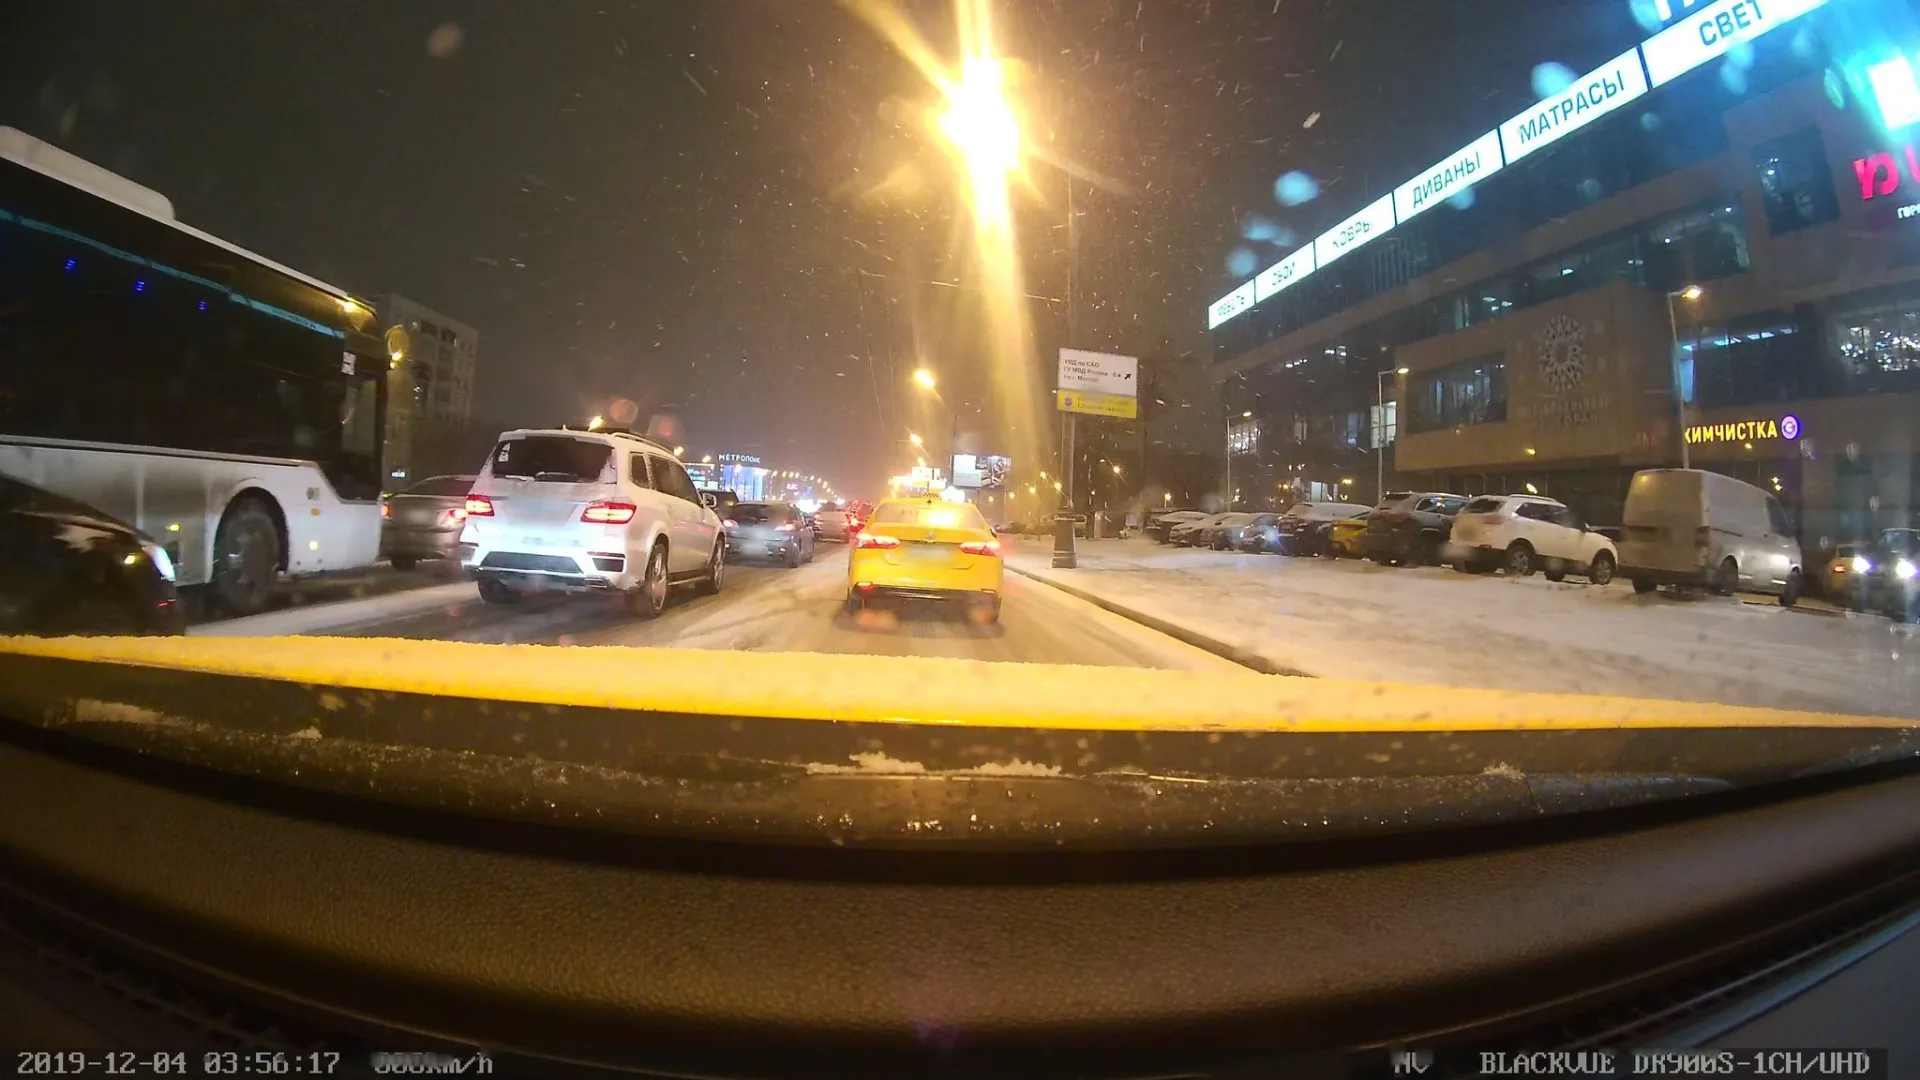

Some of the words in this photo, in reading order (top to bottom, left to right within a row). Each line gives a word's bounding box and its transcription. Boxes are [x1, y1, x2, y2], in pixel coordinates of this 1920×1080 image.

[1699, 0, 1763, 46] СВЕТ
[1519, 70, 1625, 145] МАТРАСЫ
[1412, 152, 1481, 208] ДИВАНЫ
